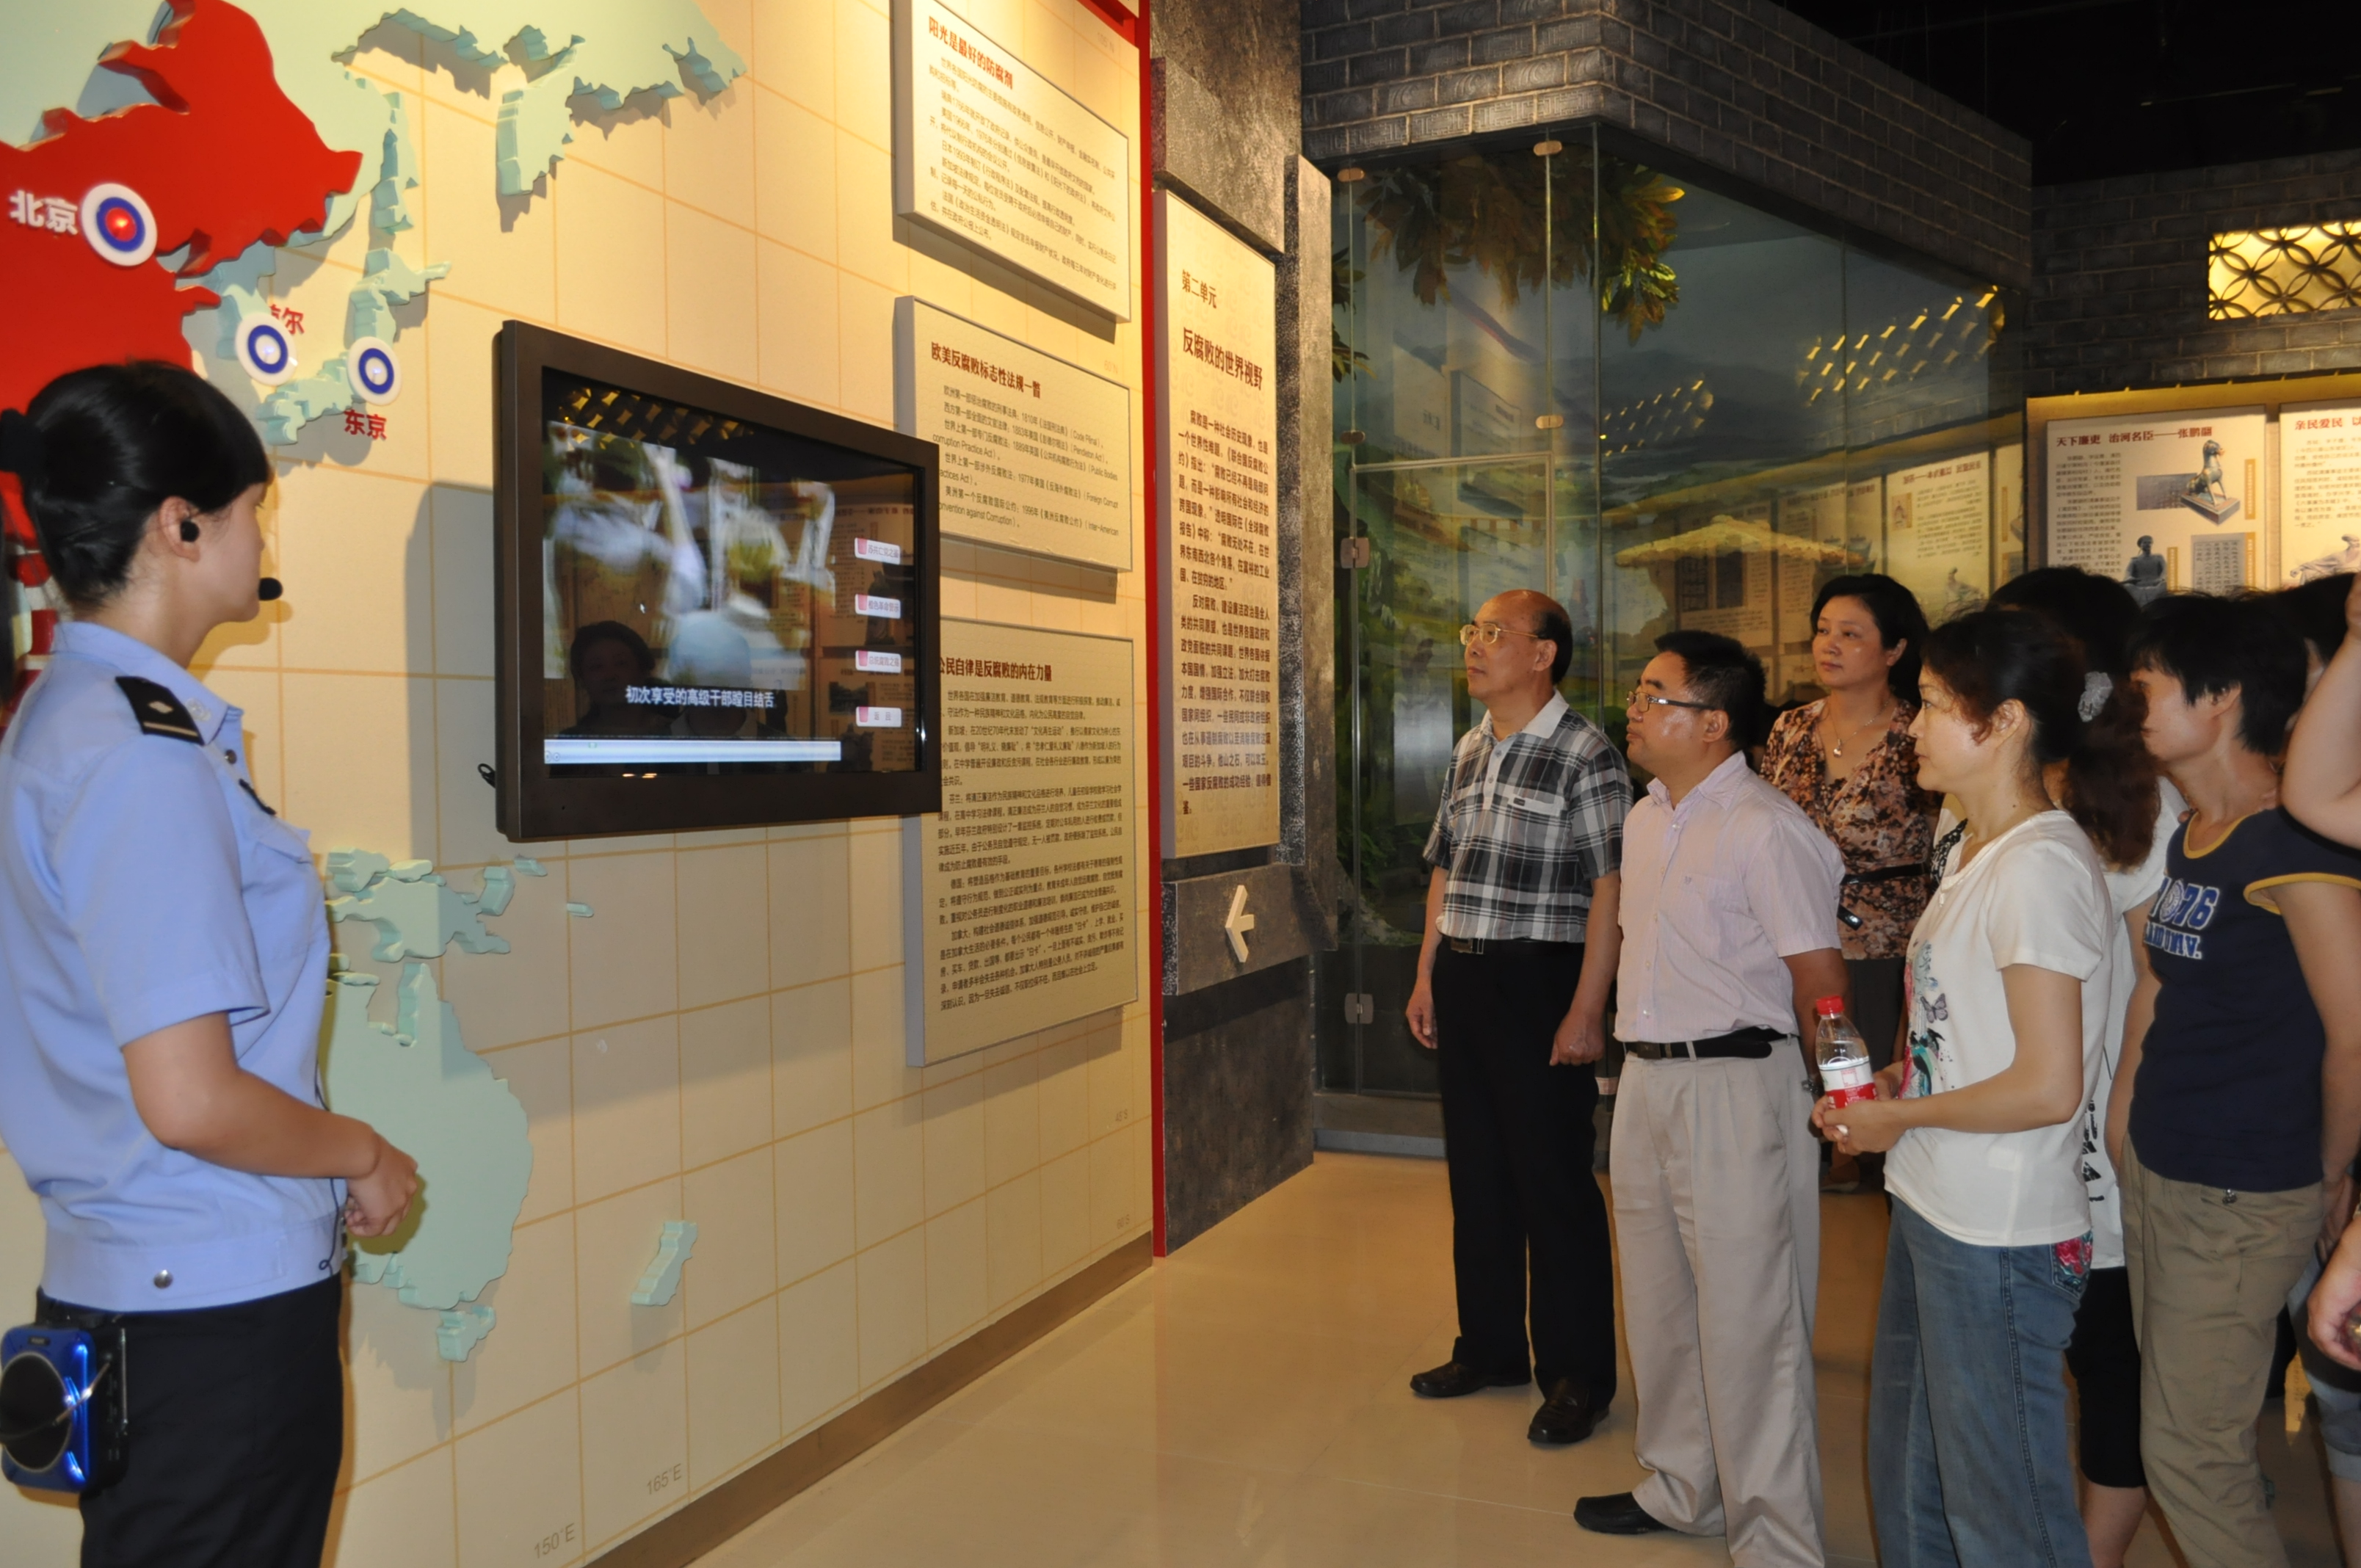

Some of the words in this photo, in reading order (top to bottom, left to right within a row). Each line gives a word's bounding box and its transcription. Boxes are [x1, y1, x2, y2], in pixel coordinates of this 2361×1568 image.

[929, 15, 1012, 90] 阳光是最好的防腐剂
[10, 189, 79, 236] 北京
[1182, 267, 1216, 309] 第二单元
[932, 341, 1041, 399] 欧美反腐败标志性法规一瞥
[1183, 325, 1262, 391] 反腐败的世界视野
[344, 408, 388, 441] 东京
[2295, 417, 2343, 430] 亲民爱民
[932, 431, 960, 450] corruption
[961, 440, 982, 455] Practice
[2056, 435, 2101, 447] 天下廉吏
[940, 466, 958, 480] actices
[938, 500, 965, 515] onvention
[966, 507, 984, 521] against
[625, 685, 774, 708] 初次享受的高级干部瞠目结舌
[942, 775, 962, 786] 会共识。
[646, 1464, 682, 1495] 165°E
[534, 1522, 575, 1558] 150°E
